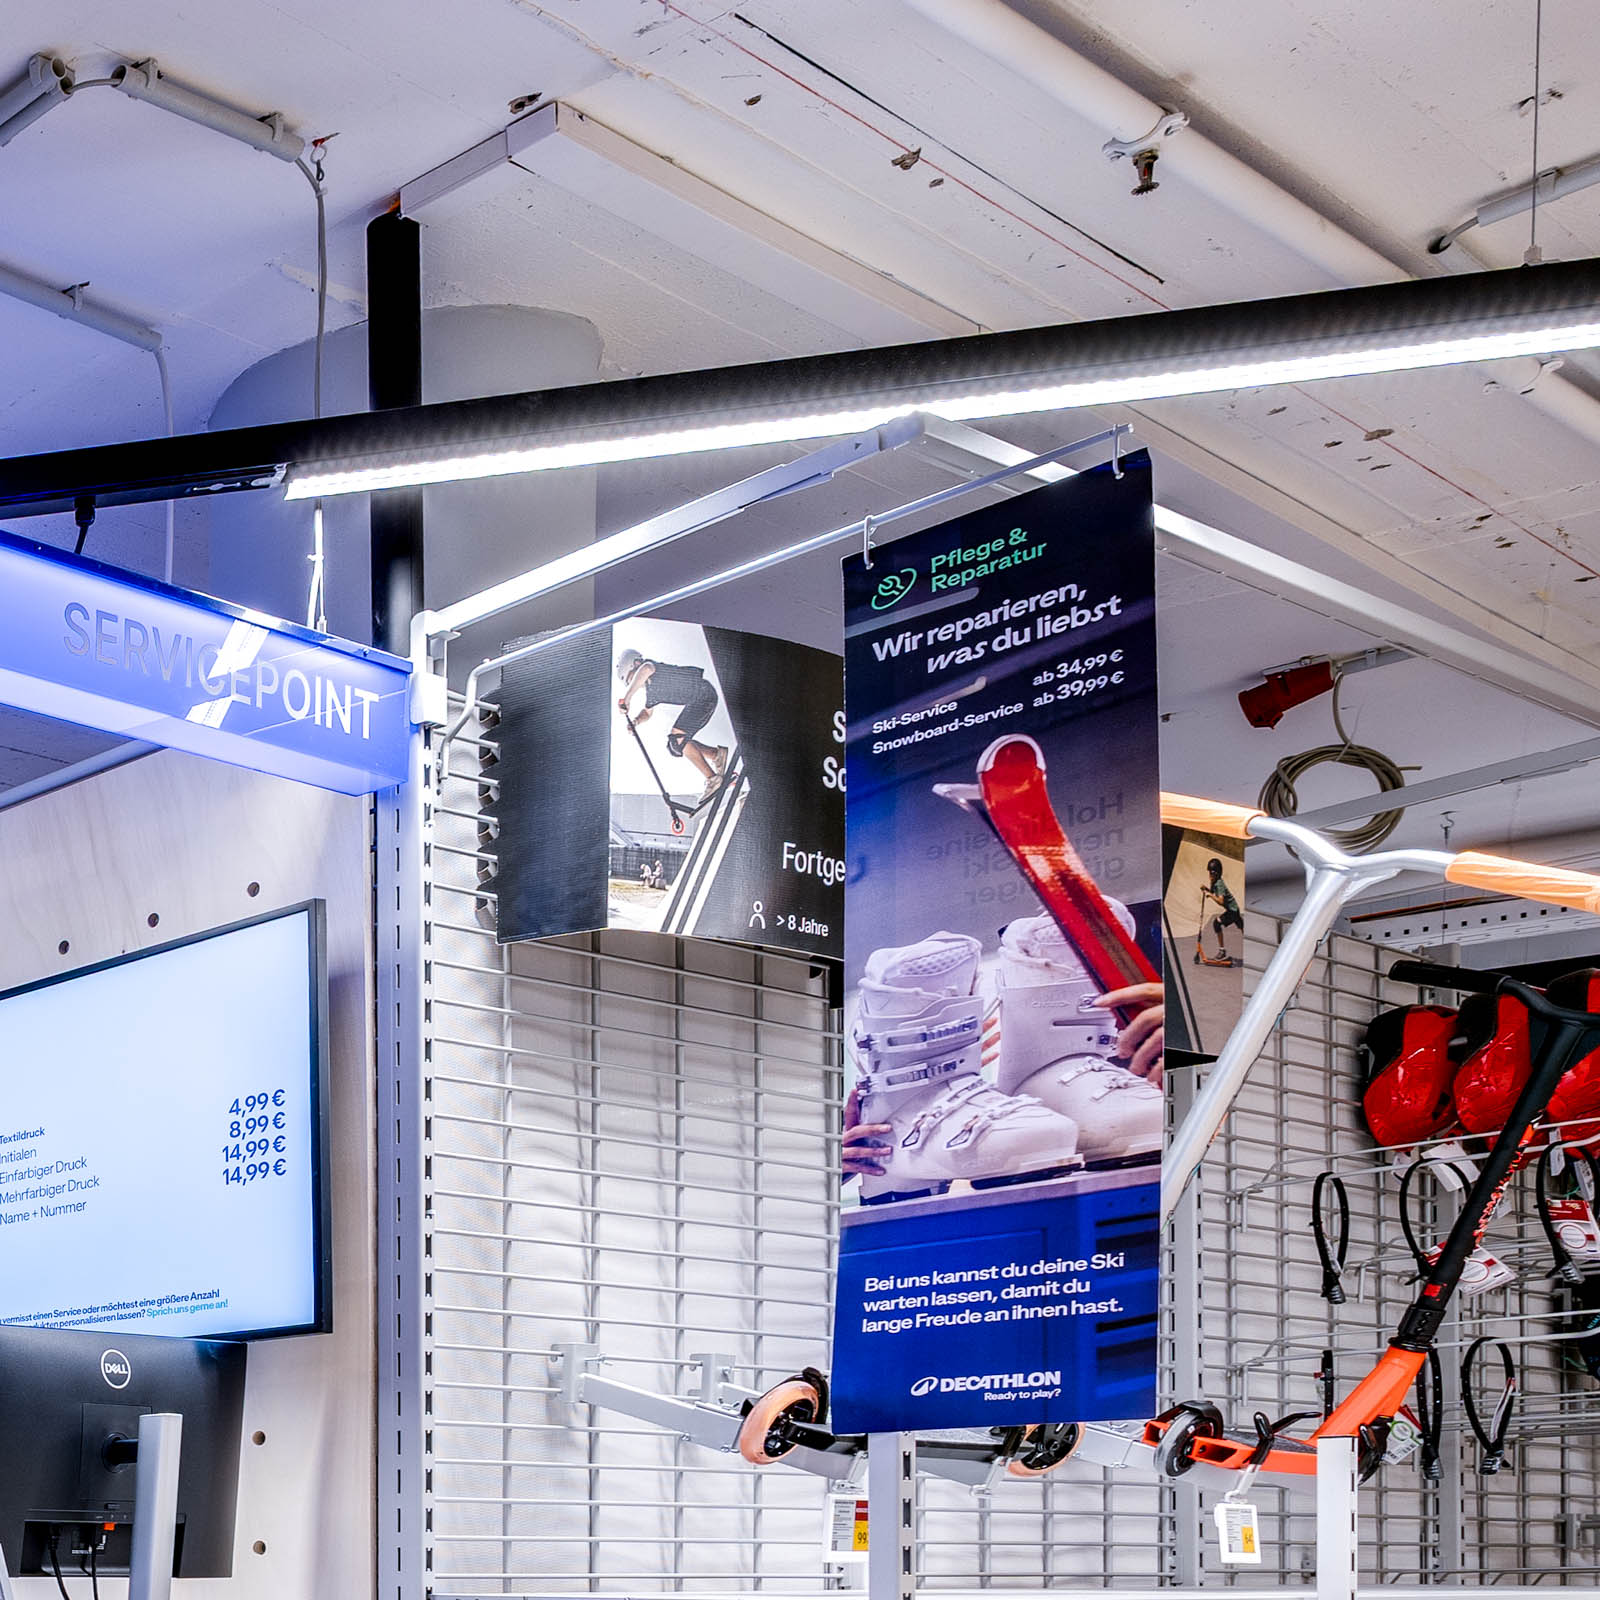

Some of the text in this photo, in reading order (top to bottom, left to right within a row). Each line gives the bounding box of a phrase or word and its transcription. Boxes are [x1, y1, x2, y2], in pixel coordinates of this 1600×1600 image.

[930, 527, 1028, 574] Pflege &
[931, 542, 1047, 593] Reparatur
[872, 583, 1087, 662] Wir reparieren,
[927, 594, 1122, 673] was du liebst
[1033, 649, 1124, 687] ab 34,99 €
[1033, 670, 1125, 708] ab 39,99 €
[872, 700, 958, 734] Ski-Service
[872, 702, 1024, 755] Snowboard-Service
[788, 914, 796, 930] 8
[798, 916, 829, 937] Jahre
[229, 1089, 285, 1118] 4,99 €
[229, 1111, 286, 1140] 8,99 €
[222, 1135, 286, 1163] 14,99 €
[0, 1156, 88, 1184] Einfarbiger Druck
[222, 1158, 287, 1186] 14,99 €
[0, 1176, 100, 1205] Mehrfarbiger Druck
[0, 1201, 87, 1225] Name Nummer
[864, 1252, 1125, 1293] Bei uns kannst du deine Ski
[33, 1312, 53, 1321] einen
[53, 1307, 82, 1318] Service
[82, 1304, 100, 1314] oder
[100, 1300, 138, 1312] möchtest
[139, 1298, 156, 1307] eine
[156, 1294, 189, 1307] größere
[190, 1289, 220, 1301] Anzahl
[863, 1278, 1091, 1313] warten lassen, damit du
[117, 1309, 146, 1320] lassen?
[147, 1306, 173, 1318] Sprich
[861, 1297, 1124, 1335] lange Freude an ihnen hast.
[105, 1363, 128, 1375] DELL
[940, 1370, 1061, 1393] DECATHLON
[984, 1388, 1061, 1402] Ready to play?
